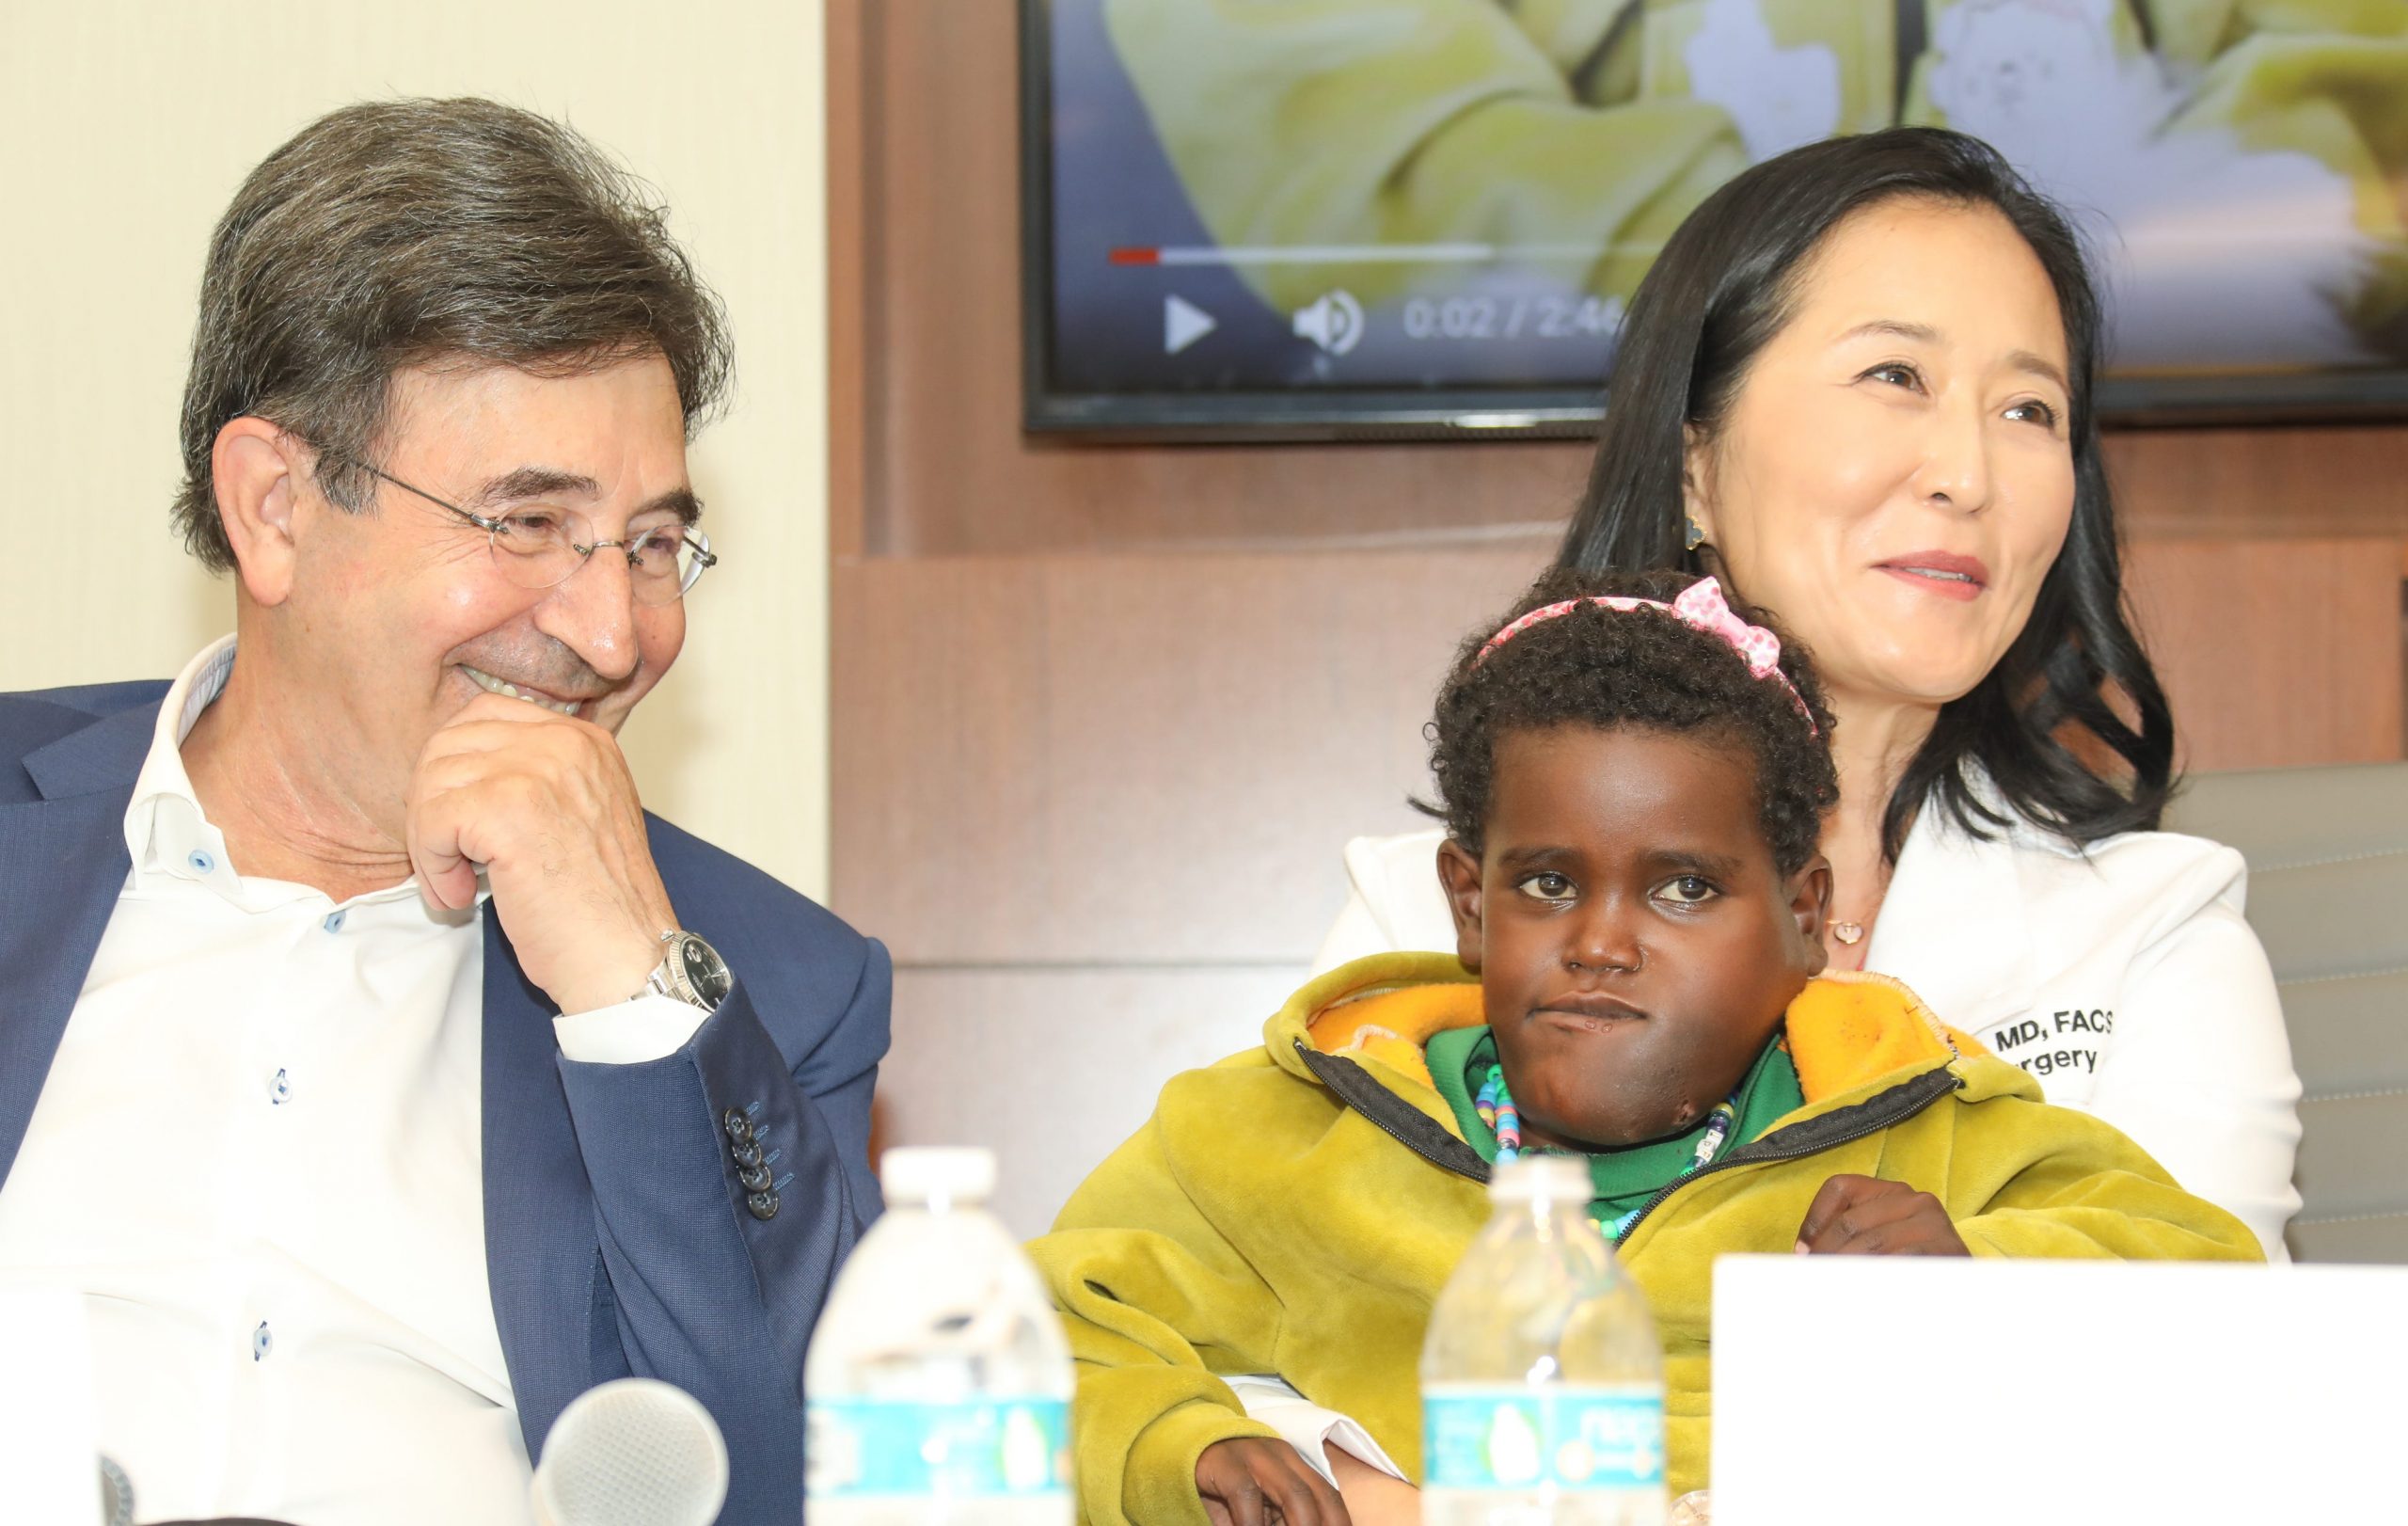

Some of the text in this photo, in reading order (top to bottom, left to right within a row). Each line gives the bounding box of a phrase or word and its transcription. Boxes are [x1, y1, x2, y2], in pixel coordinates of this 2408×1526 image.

[1403, 297, 1497, 339] 0:02
[1504, 299, 1529, 340] /
[1995, 1009, 2113, 1052] MD, FACS
[2016, 1049, 2098, 1076] rgery
